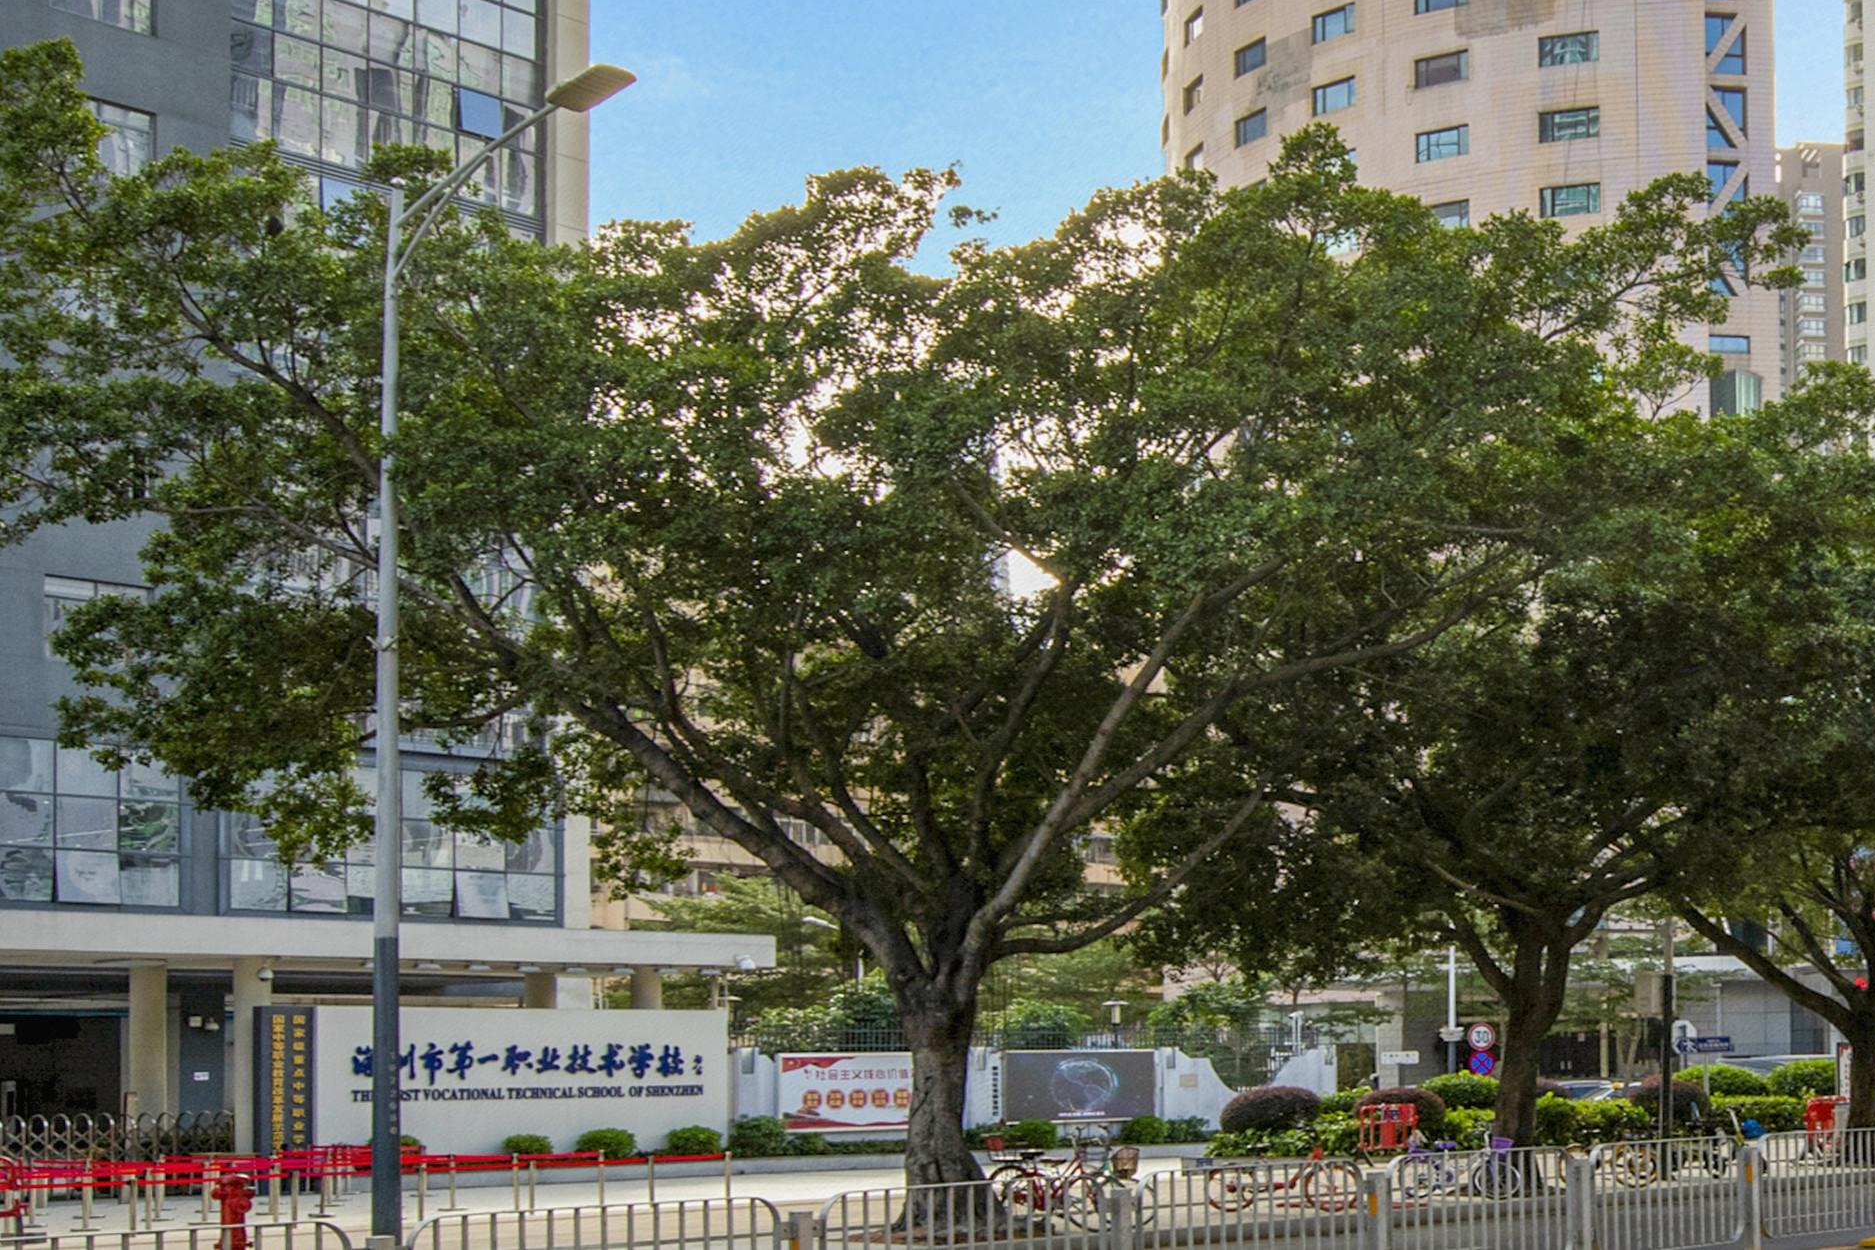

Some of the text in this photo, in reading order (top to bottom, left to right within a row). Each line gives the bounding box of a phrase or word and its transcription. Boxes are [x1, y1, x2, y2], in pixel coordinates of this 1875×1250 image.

[1474, 1030, 1490, 1044] 30
[352, 1090, 373, 1102] TH
[424, 1087, 504, 1101] VOCATIONAL
[507, 1087, 576, 1099] TECHNICAL
[577, 1085, 625, 1098] SCHOOL
[628, 1085, 645, 1097] OF
[645, 1084, 703, 1096] SHENZHEN
